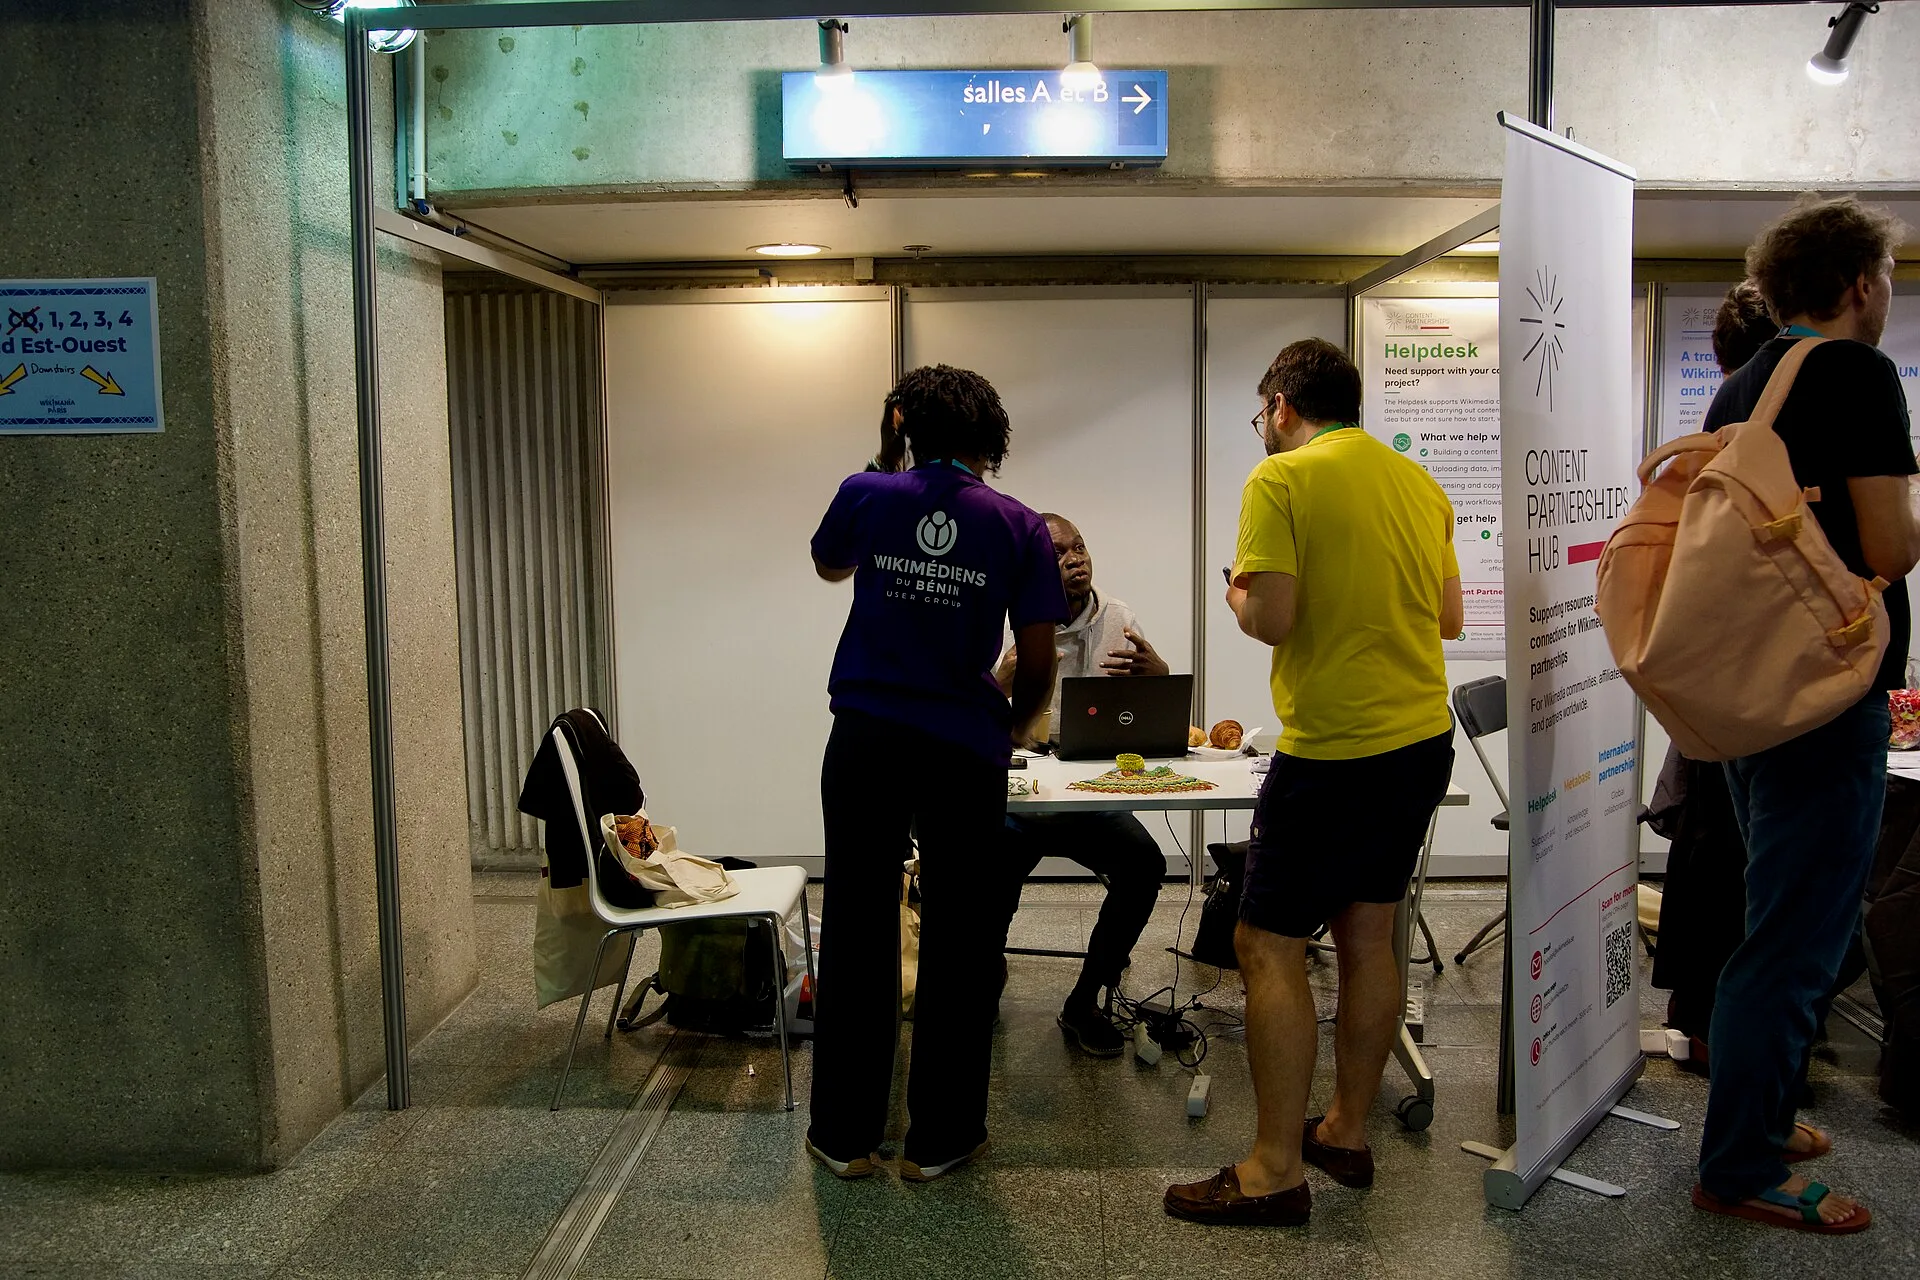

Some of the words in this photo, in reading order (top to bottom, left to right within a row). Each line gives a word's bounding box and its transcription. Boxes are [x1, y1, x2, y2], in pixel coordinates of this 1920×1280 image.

[963, 80, 1026, 103] salles
[1031, 80, 1052, 103] A
[1093, 80, 1109, 103] B
[49, 311, 64, 331] 1,
[69, 311, 88, 331] 2,
[93, 310, 112, 330] 3,
[118, 310, 133, 327] 4
[21, 337, 128, 354] Est-Ouest
[1384, 342, 1479, 363] Helpdesk
[1681, 351, 1690, 362] A
[1385, 367, 1408, 376] Need
[1410, 367, 1445, 379] support
[1448, 367, 1467, 376] with
[1469, 368, 1489, 377] your
[1384, 379, 1420, 389] project?
[1680, 385, 1706, 396] and
[1398, 399, 1428, 407] Helpdesk
[1429, 399, 1459, 407] supports
[1420, 433, 1446, 441] What
[1467, 432, 1488, 444] help
[1433, 449, 1462, 458] Building
[1432, 466, 1467, 474] Uploading
[1470, 465, 1490, 473] data,
[1525, 449, 1588, 486] CONTENT
[1527, 486, 1629, 530] PARTNERSHIPS
[1456, 516, 1472, 525] get
[1476, 514, 1497, 525] help
[1528, 534, 1559, 574] HUB
[874, 554, 987, 587] WIKIMÉDIENS
[896, 578, 911, 586] DU
[916, 580, 960, 597] BÉNIN
[886, 591, 916, 600] USER
[924, 596, 961, 608] GROUP
[1529, 600, 1564, 625] Supporting
[1564, 594, 1594, 613] resources
[1530, 626, 1567, 650] connections
[1567, 619, 1577, 637] for
[1530, 650, 1568, 680] partnerships
[1530, 697, 1544, 713] For
[1531, 718, 1545, 734] and
[1598, 737, 1636, 764] International
[1563, 770, 1592, 793] Metabase
[1528, 786, 1557, 814] Helpdesk
[1601, 897, 1613, 912] Scan
[1613, 892, 1622, 903] for
